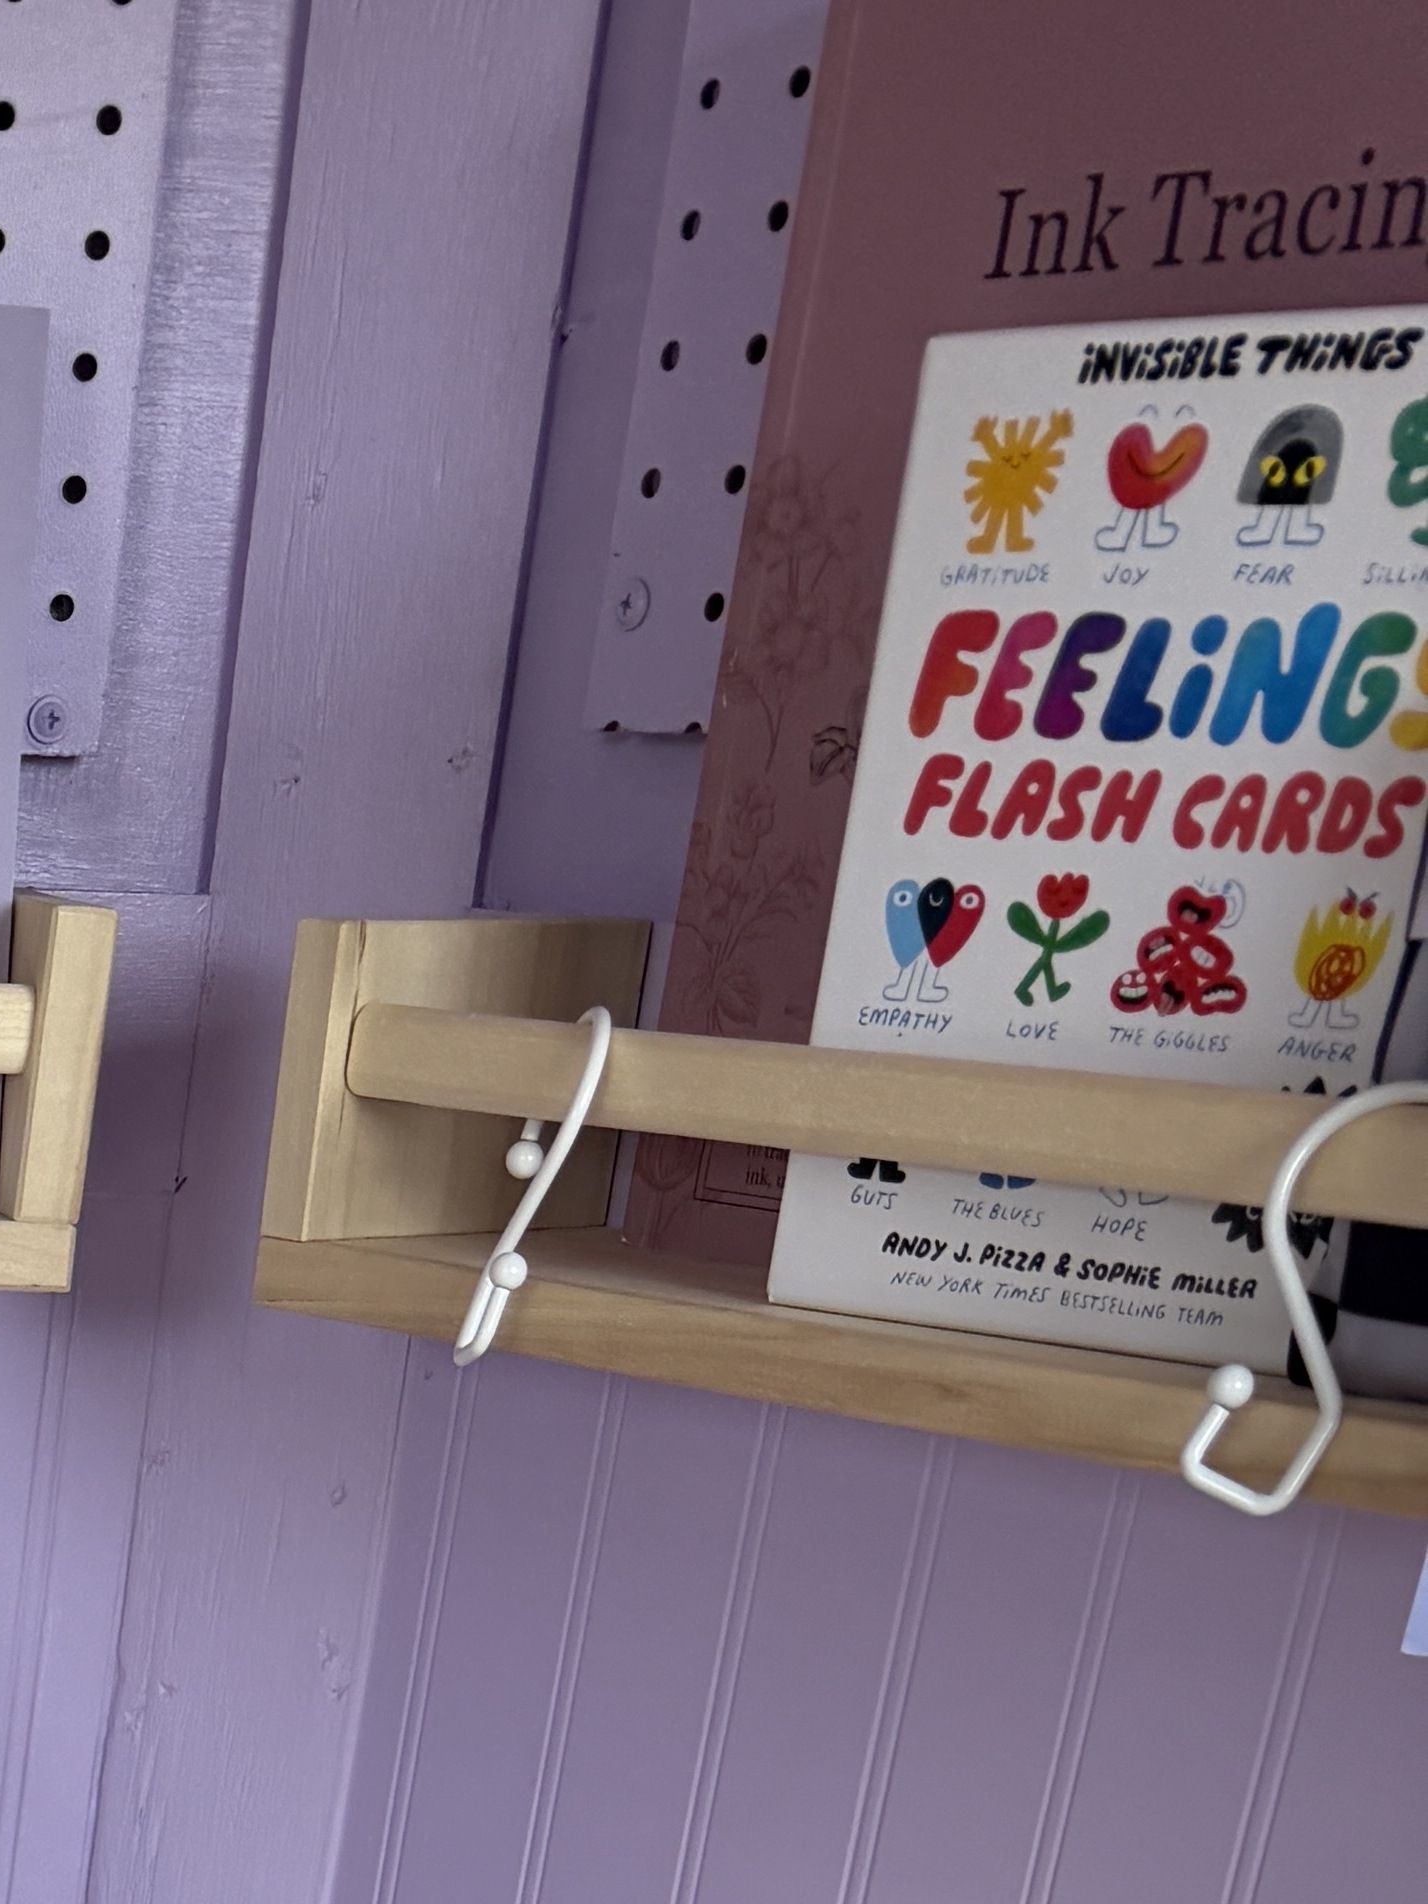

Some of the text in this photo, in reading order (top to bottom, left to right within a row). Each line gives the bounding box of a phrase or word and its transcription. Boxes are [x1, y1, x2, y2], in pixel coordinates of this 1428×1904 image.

[984, 172, 1126, 280] Ink
[1102, 564, 1151, 587] JOY
[1233, 562, 1295, 587] FEAR
[903, 753, 1427, 860] FLASH CARDS
[858, 1005, 953, 1033] EMPATHY
[1005, 1020, 1060, 1042] LOVE
[1278, 1036, 1357, 1063] ANGER
[1090, 1215, 1148, 1243] HOPE
[881, 1231, 948, 1264] ANDY
[978, 1242, 1045, 1274] PIZZA
[1076, 1256, 1161, 1289] SOPHIE
